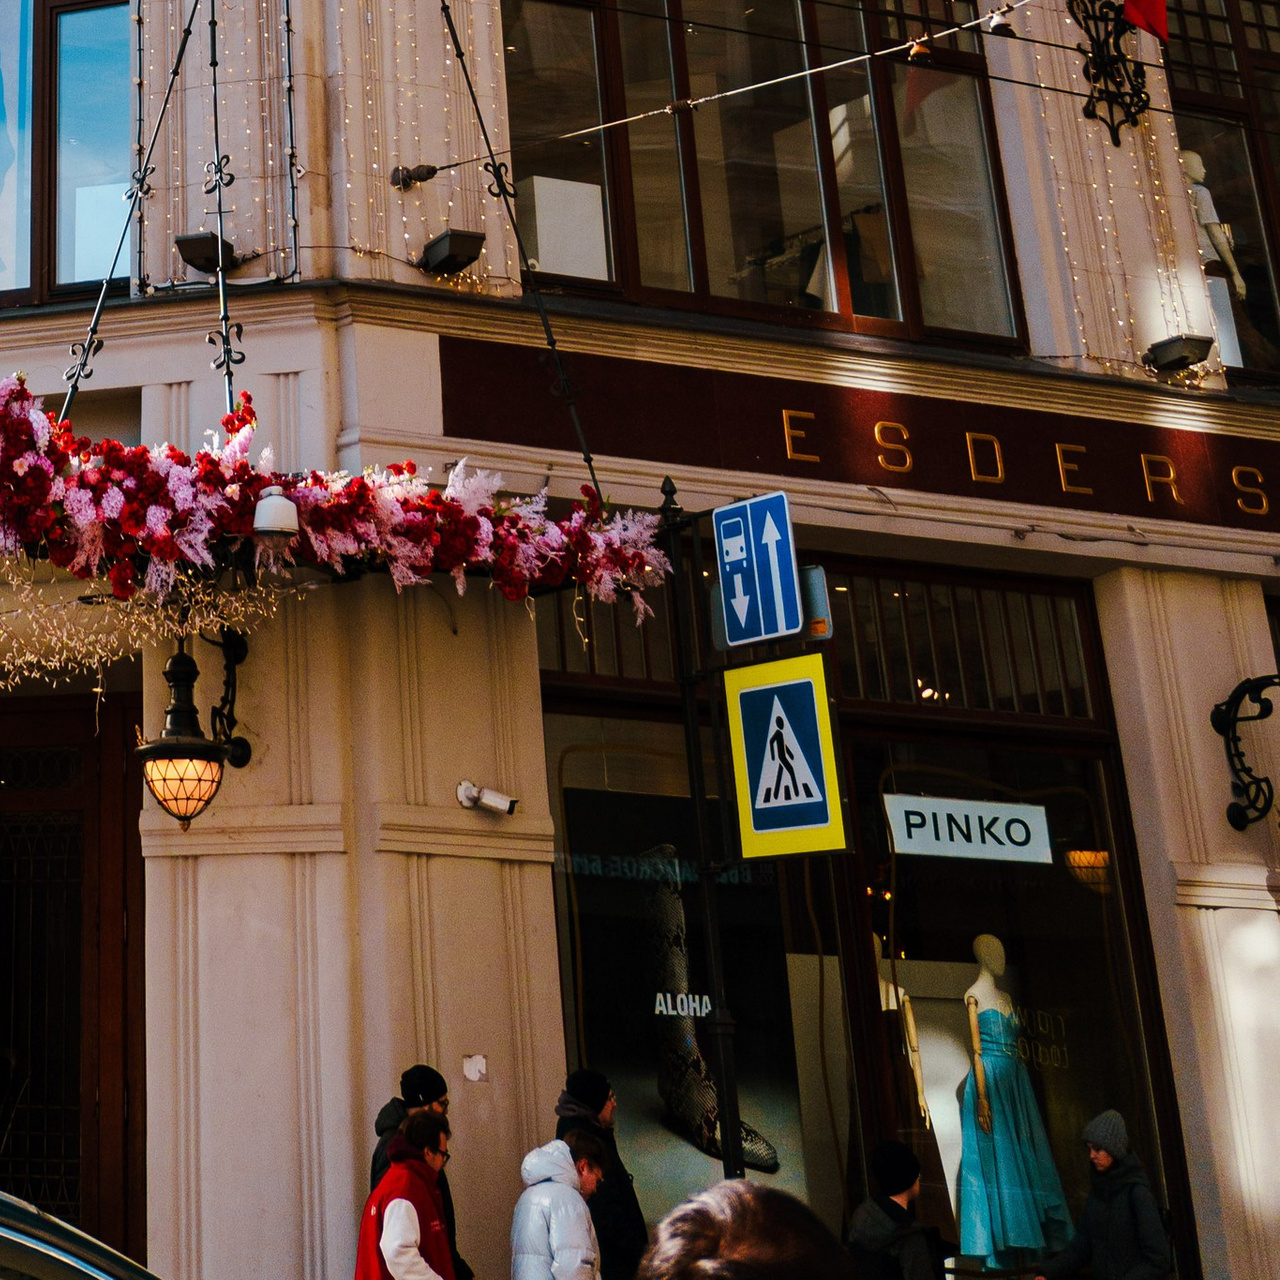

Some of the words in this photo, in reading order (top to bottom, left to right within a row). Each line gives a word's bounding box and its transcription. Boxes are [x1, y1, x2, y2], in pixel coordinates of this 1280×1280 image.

[781, 408, 1270, 515] ESDERS
[903, 809, 1032, 847] PINKO
[654, 992, 712, 1017] ALOHA
